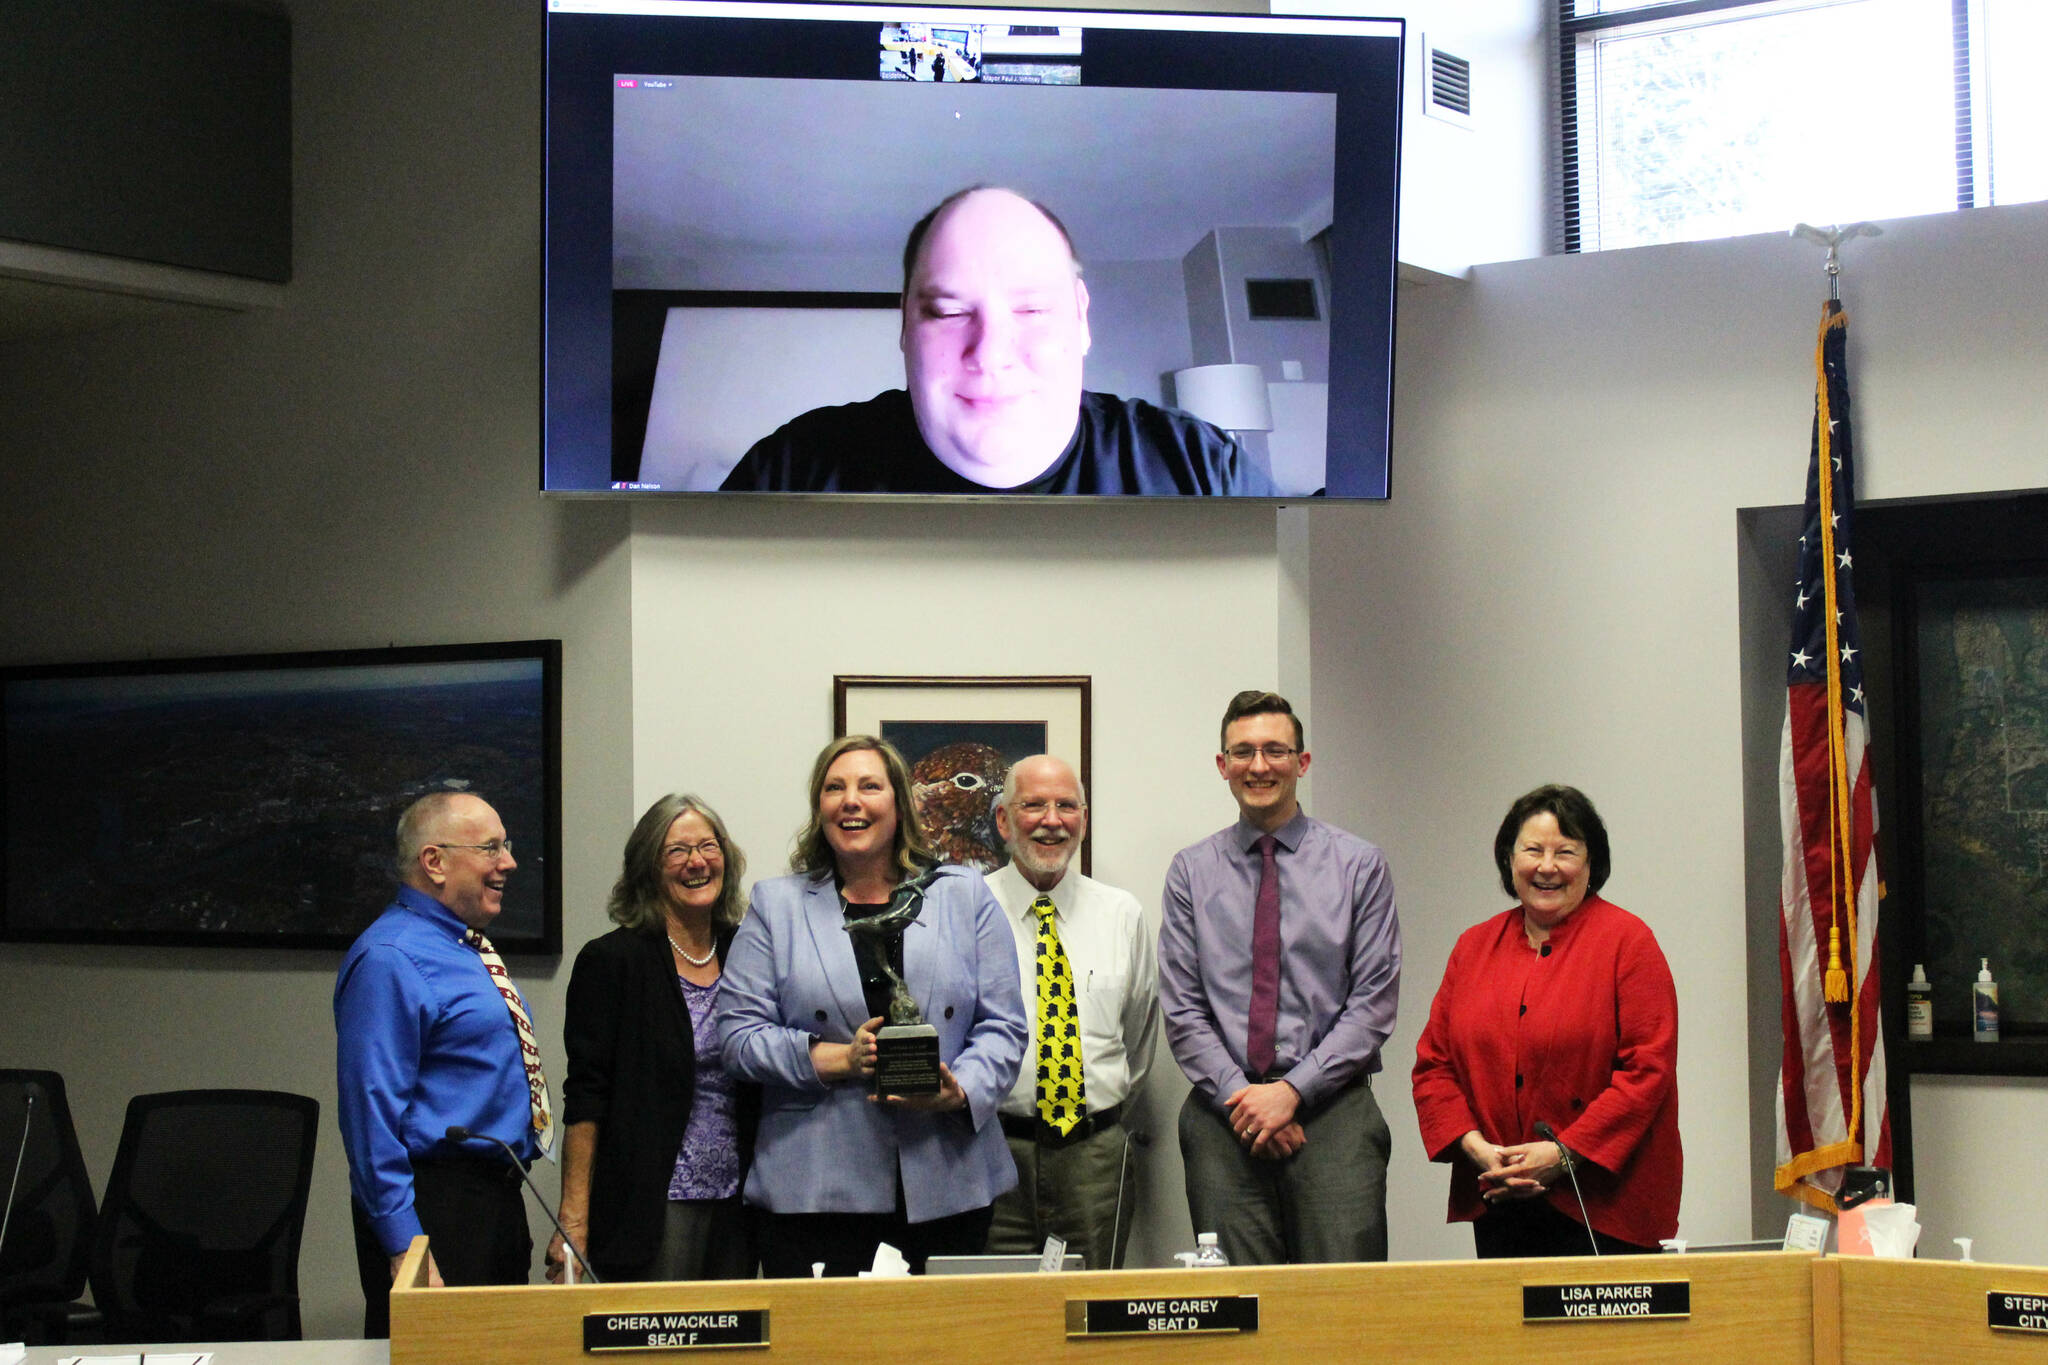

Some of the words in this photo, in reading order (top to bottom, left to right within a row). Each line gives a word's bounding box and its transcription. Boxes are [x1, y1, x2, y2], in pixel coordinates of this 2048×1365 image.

[1561, 1288, 1593, 1300] LISA
[1596, 1286, 1653, 1299] PARKER
[1127, 1301, 1166, 1315] DAVE
[1169, 1300, 1219, 1313] CAREY
[1564, 1303, 1597, 1317] VICE
[1600, 1302, 1650, 1316] MAYOR
[607, 1317, 660, 1331] CHERA
[663, 1315, 738, 1329] WACKLER
[1147, 1317, 1184, 1331] SEAT
[1188, 1317, 1199, 1329] D
[647, 1333, 686, 1346] SEAT
[689, 1333, 698, 1345] F
